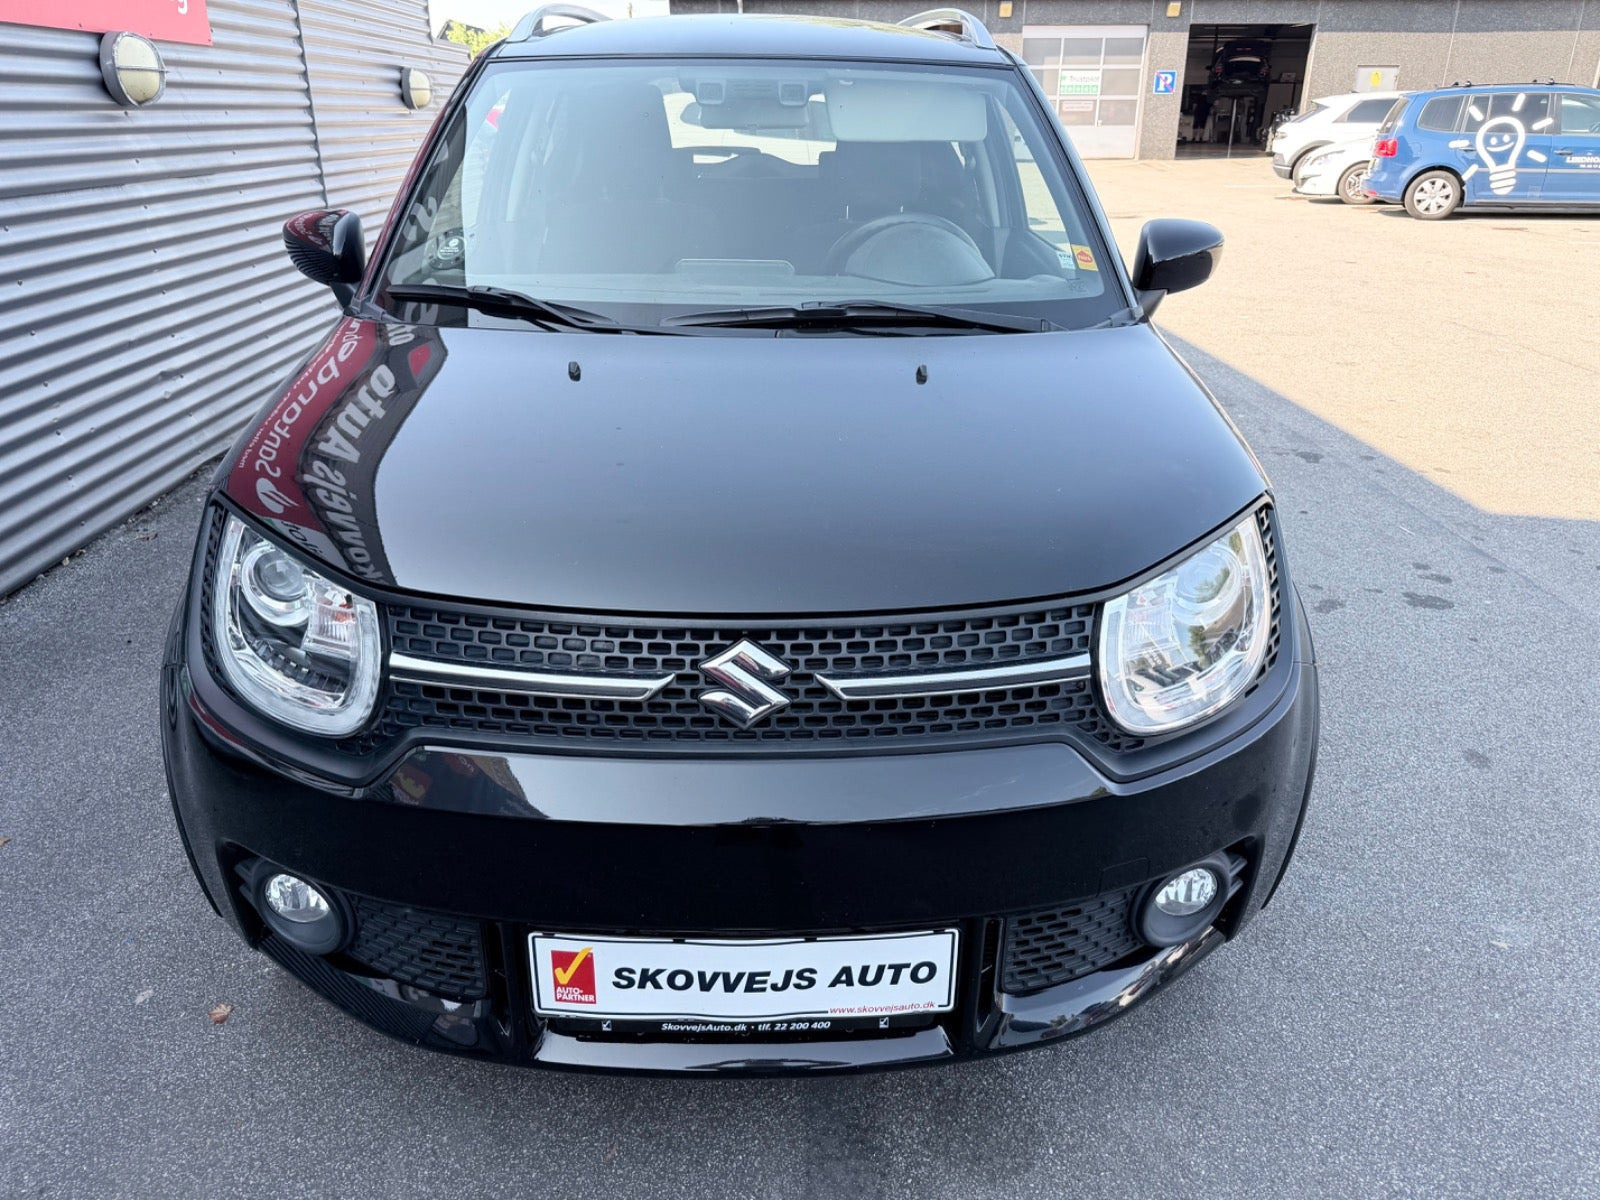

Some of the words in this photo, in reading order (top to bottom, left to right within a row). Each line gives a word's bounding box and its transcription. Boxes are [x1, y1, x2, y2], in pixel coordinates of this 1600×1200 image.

[611, 966, 818, 994] SKOVVEJS
[827, 961, 938, 988] AUTO
[556, 987, 584, 996] AUTO-
[556, 993, 596, 1003] PARTNER
[829, 1001, 936, 1014] www.skovvejsauto.dk
[661, 1022, 747, 1032] SkovvejsAuto.dk
[773, 1022, 788, 1031] 22
[789, 1022, 809, 1030] 200
[810, 1021, 831, 1030] 400
